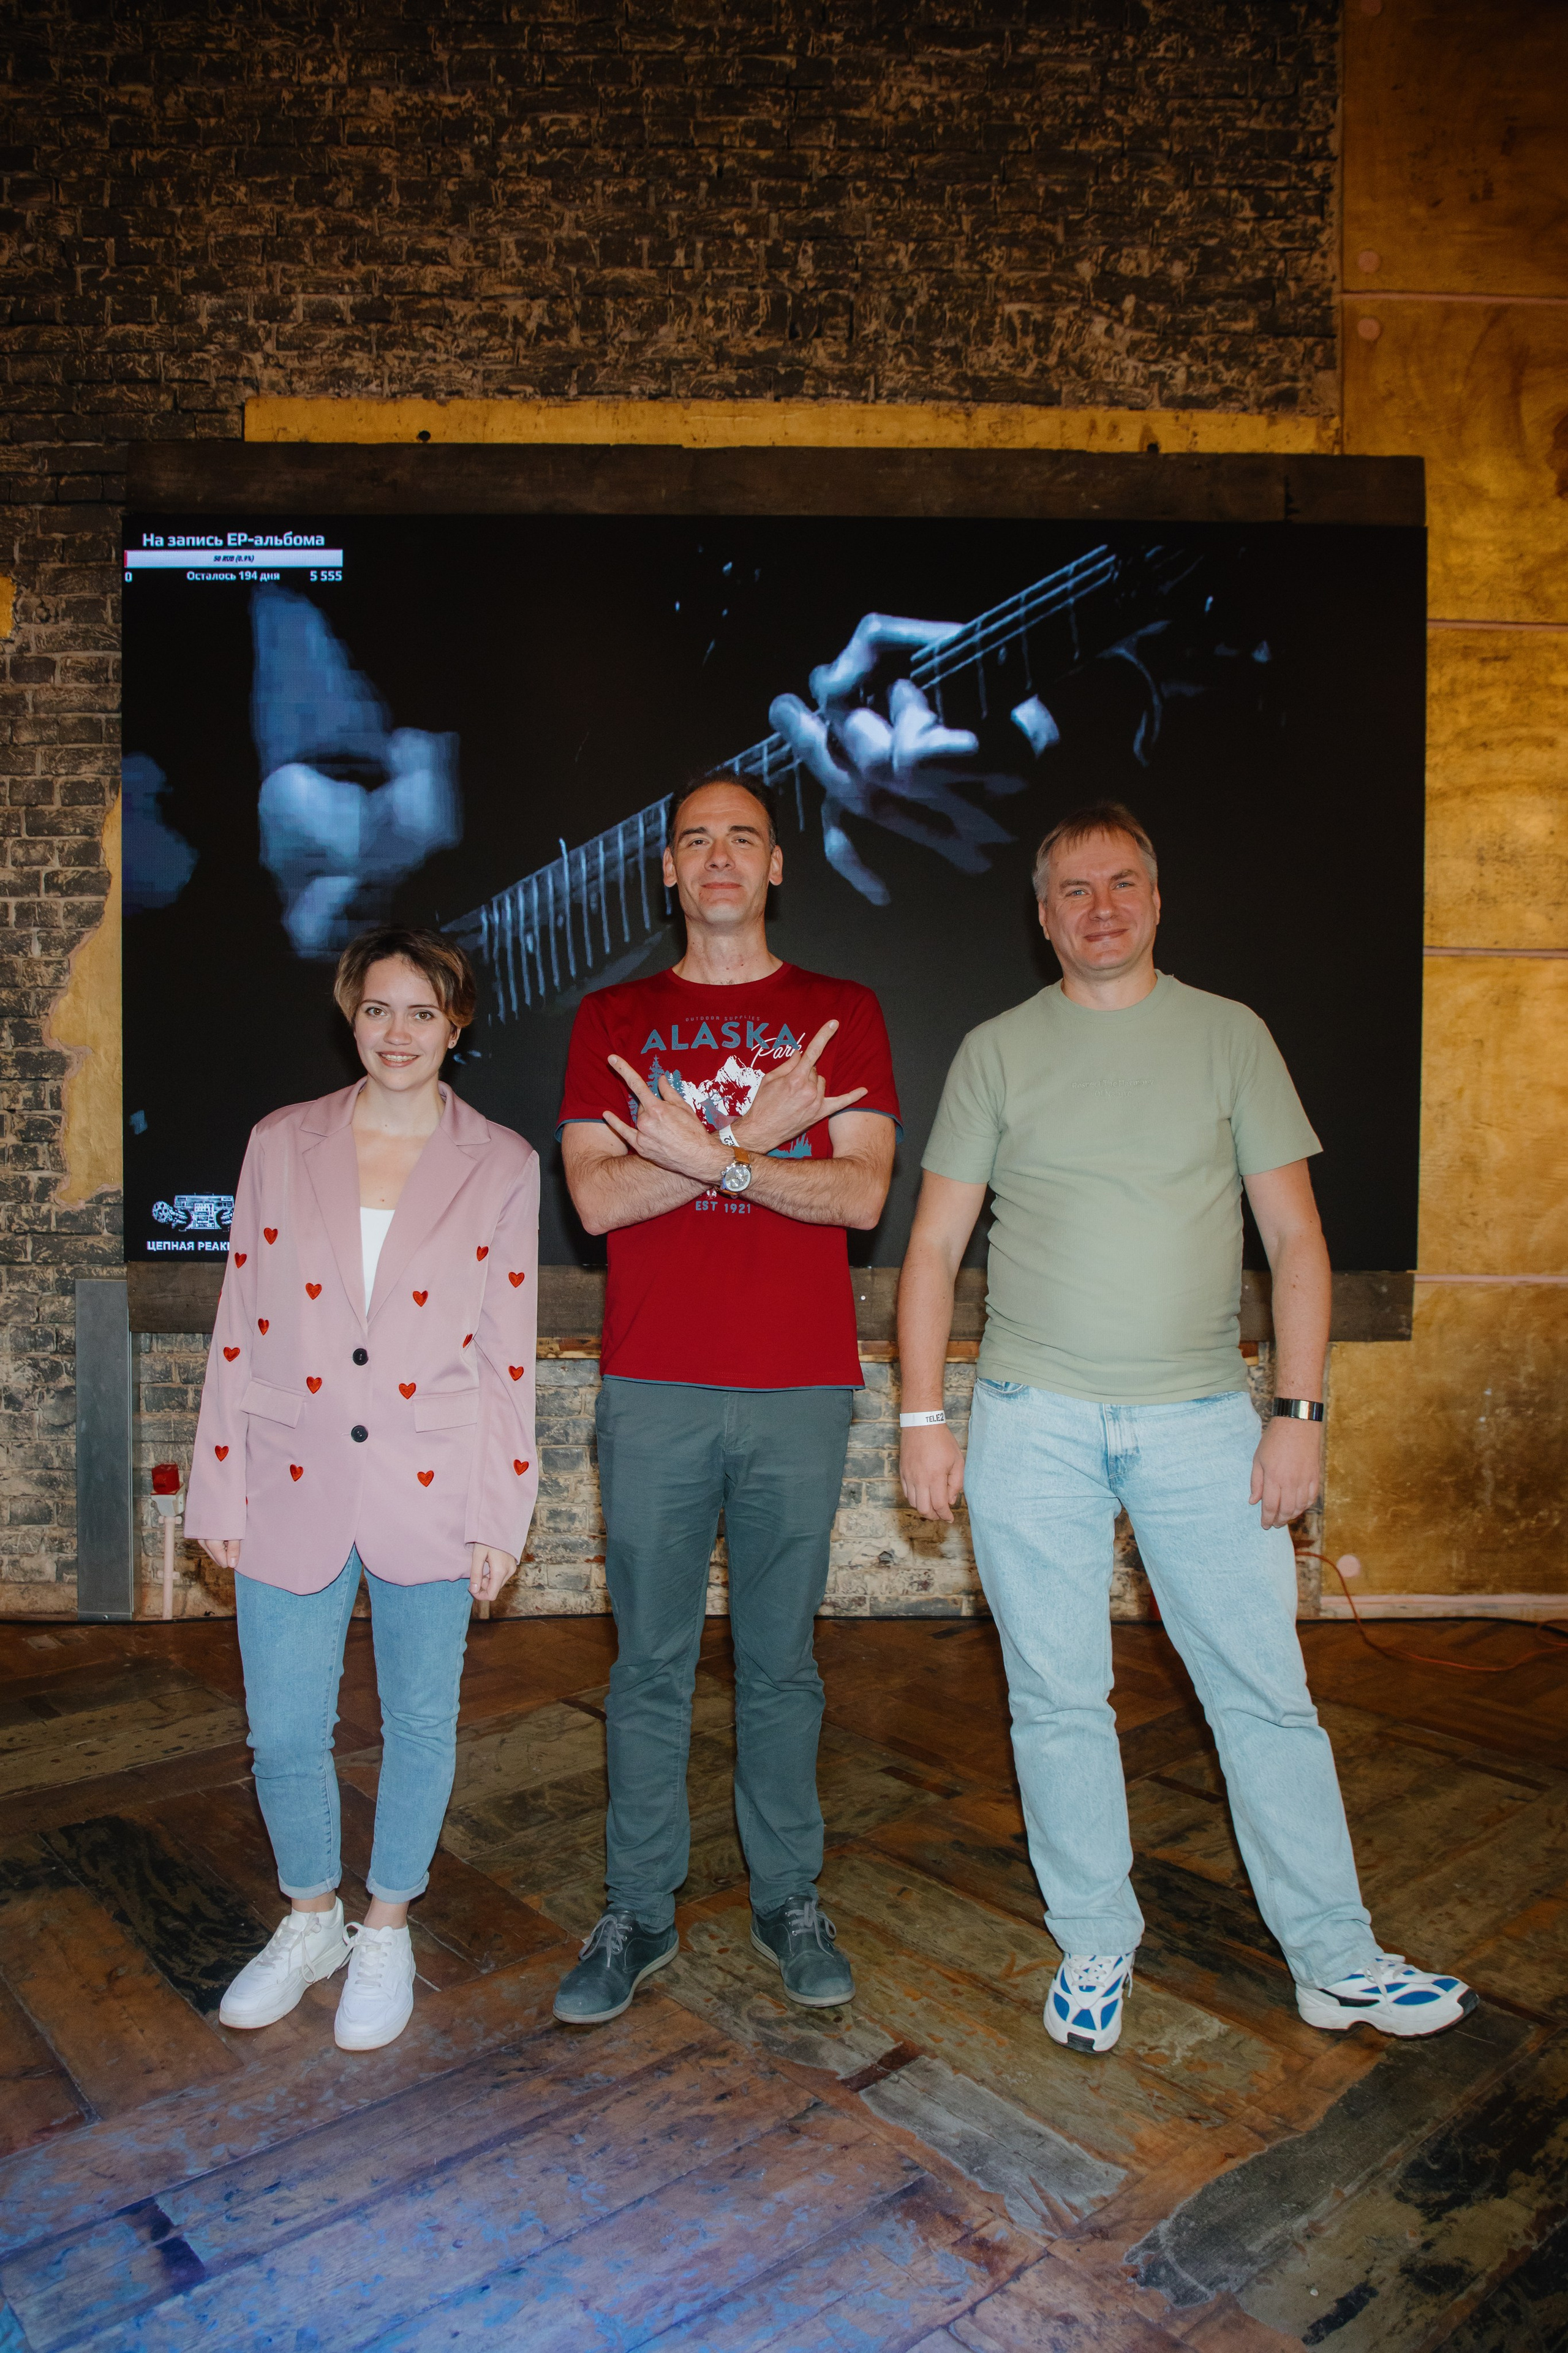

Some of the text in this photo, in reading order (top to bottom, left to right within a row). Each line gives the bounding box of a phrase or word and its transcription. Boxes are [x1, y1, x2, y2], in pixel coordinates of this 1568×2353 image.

[142, 532, 164, 546] На
[167, 535, 224, 546] запись
[124, 571, 133, 583] 0
[186, 570, 281, 582] Осталось 194 дня
[640, 1021, 799, 1054] ALASKA
[695, 1201, 751, 1214] EST 1921
[146, 1241, 195, 1252] ЦЕПНАЯ
[925, 1413, 944, 1422] TELE2
